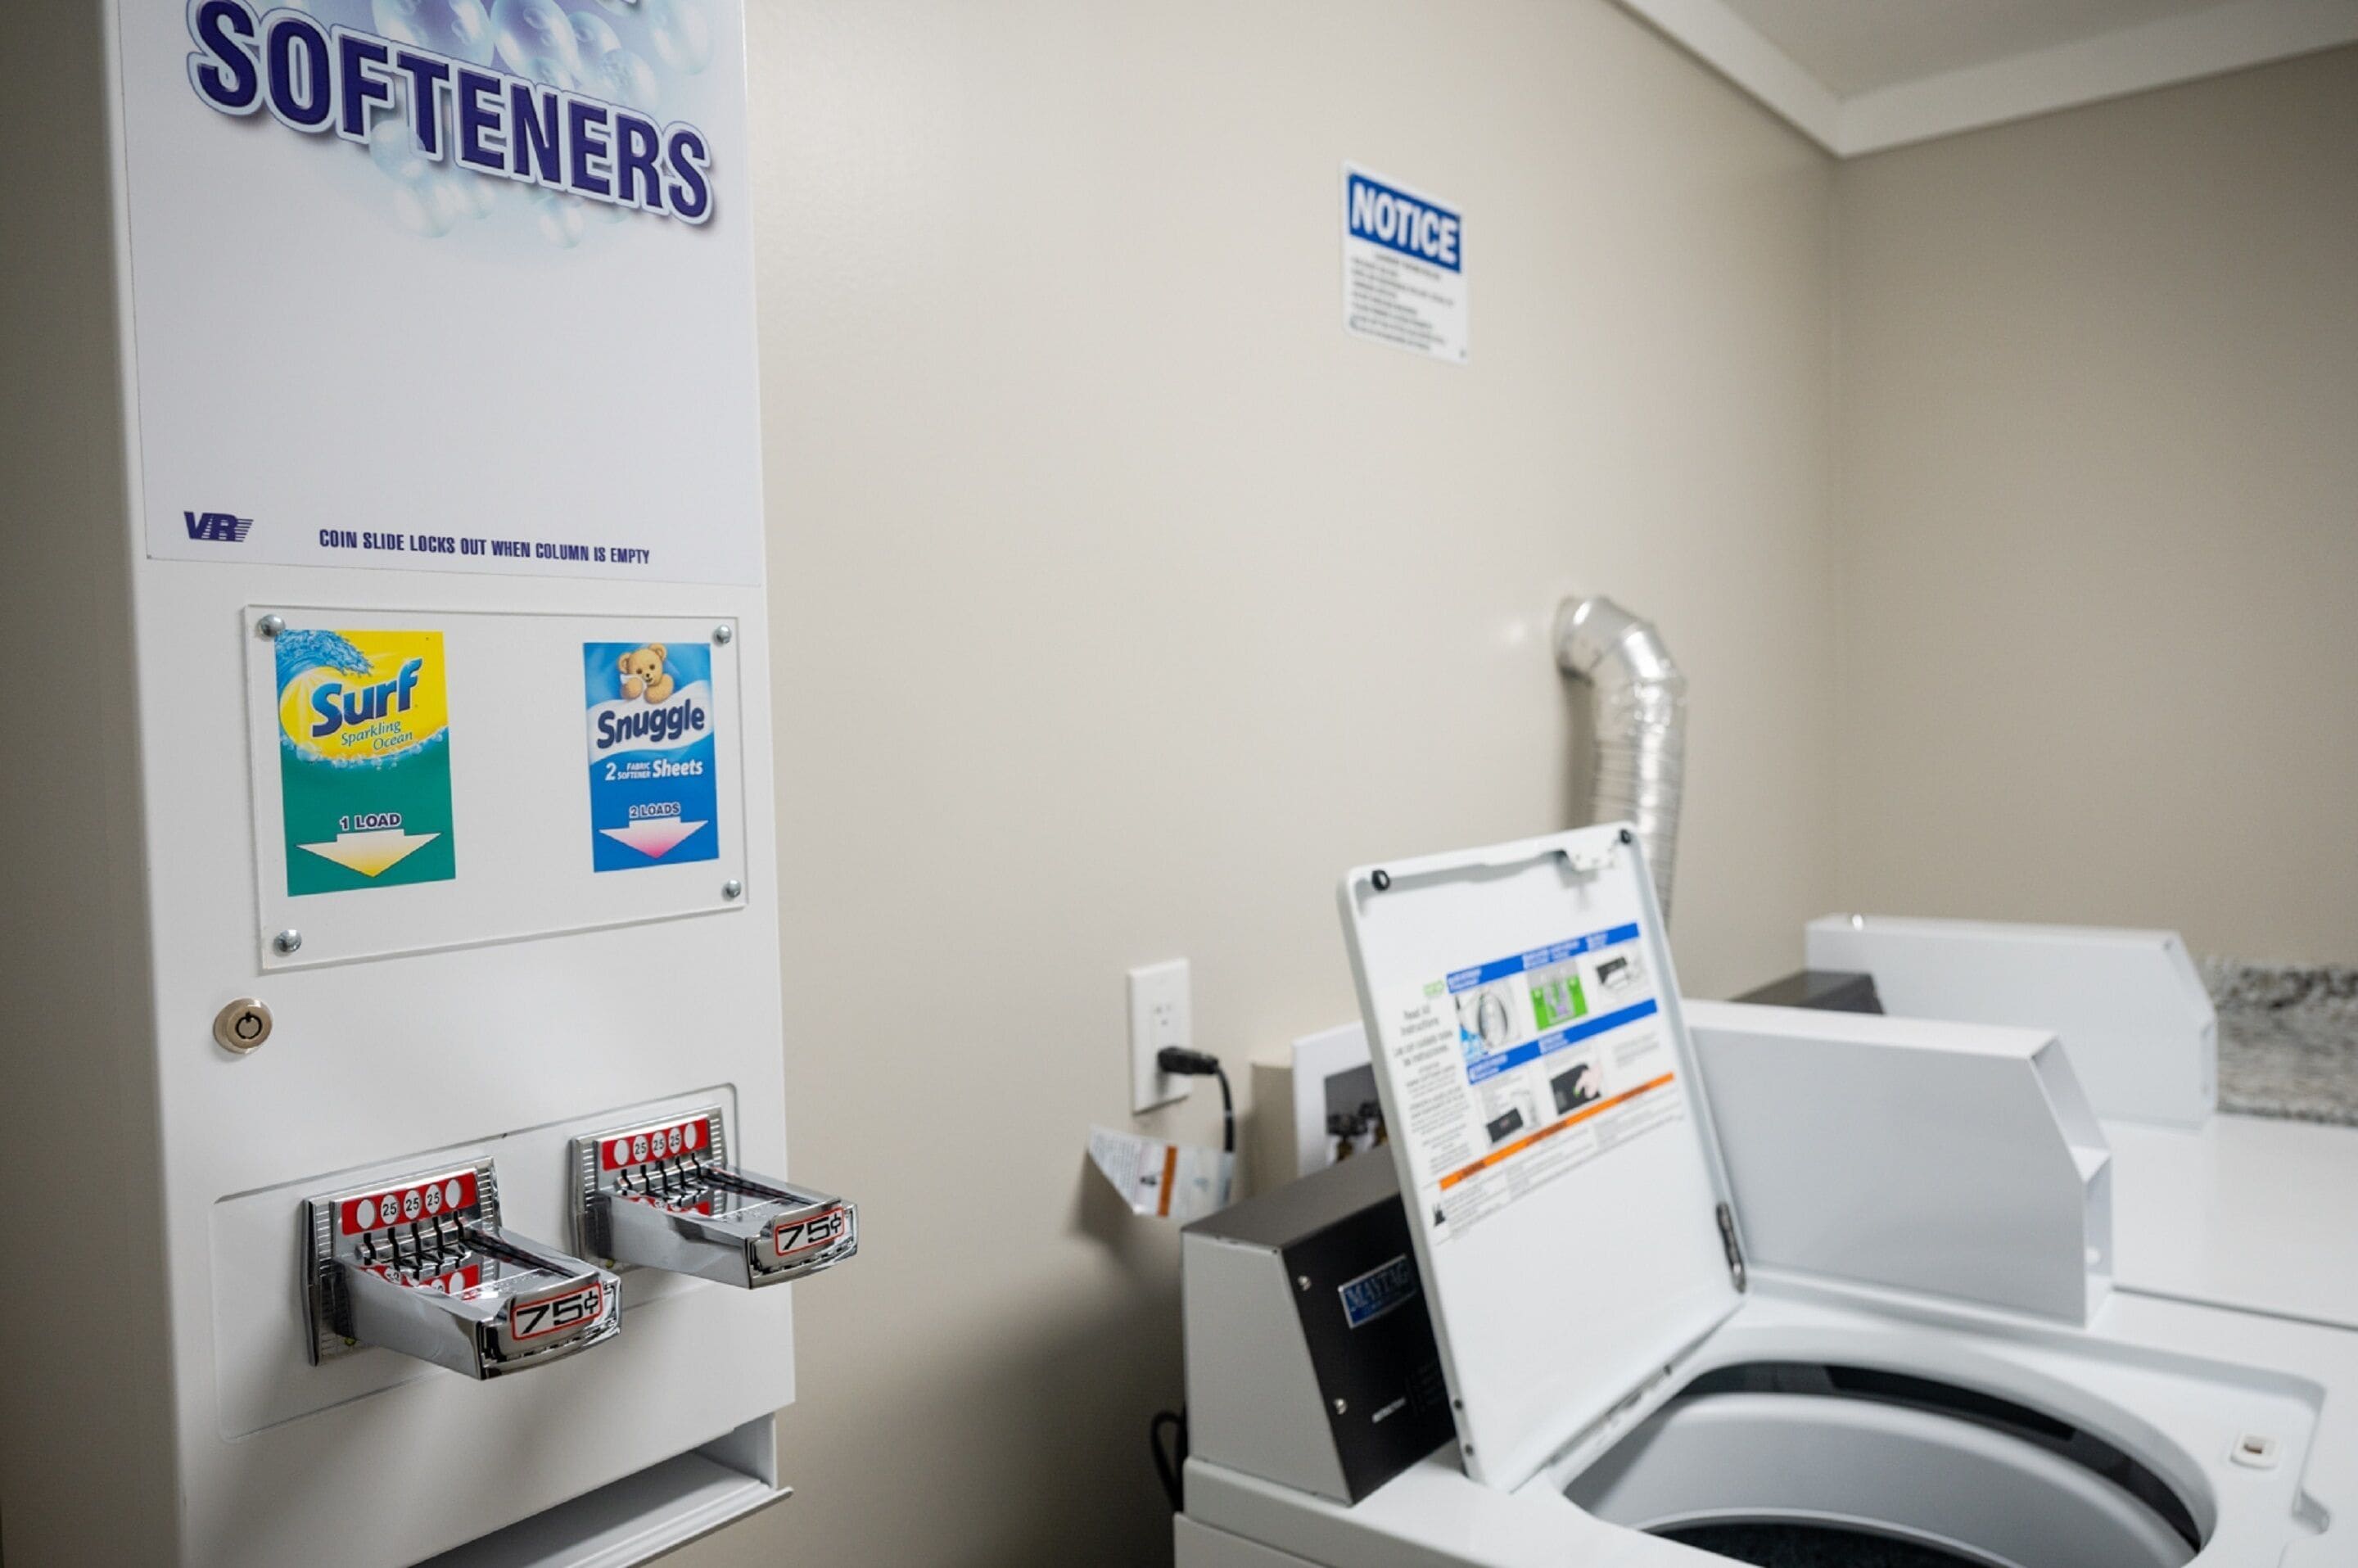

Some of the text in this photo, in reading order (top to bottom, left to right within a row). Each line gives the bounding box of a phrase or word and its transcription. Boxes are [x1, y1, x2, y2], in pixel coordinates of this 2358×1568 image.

[187, 0, 717, 225] SOFTENERS
[1351, 181, 1458, 264] NOTICE
[319, 528, 649, 564] COIN SLIDE LOCKS OUT WHEN COLUMN IS EMPTY
[312, 658, 422, 738] Surf
[597, 698, 705, 748] Snuggle
[341, 721, 401, 746] Sparkling
[373, 732, 413, 750] Ocean
[605, 762, 617, 781] 2
[653, 758, 703, 778] Sheets
[630, 802, 680, 817] 2 LOADS
[341, 814, 402, 830] 1 LOAD
[635, 1142, 647, 1155] 25
[653, 1137, 665, 1150] 25
[670, 1134, 680, 1147] 25
[405, 1198, 420, 1212] 25
[427, 1193, 440, 1206] 25
[382, 1204, 398, 1216] 25
[778, 1214, 842, 1251] 75¢
[516, 1291, 599, 1335] 75¢
